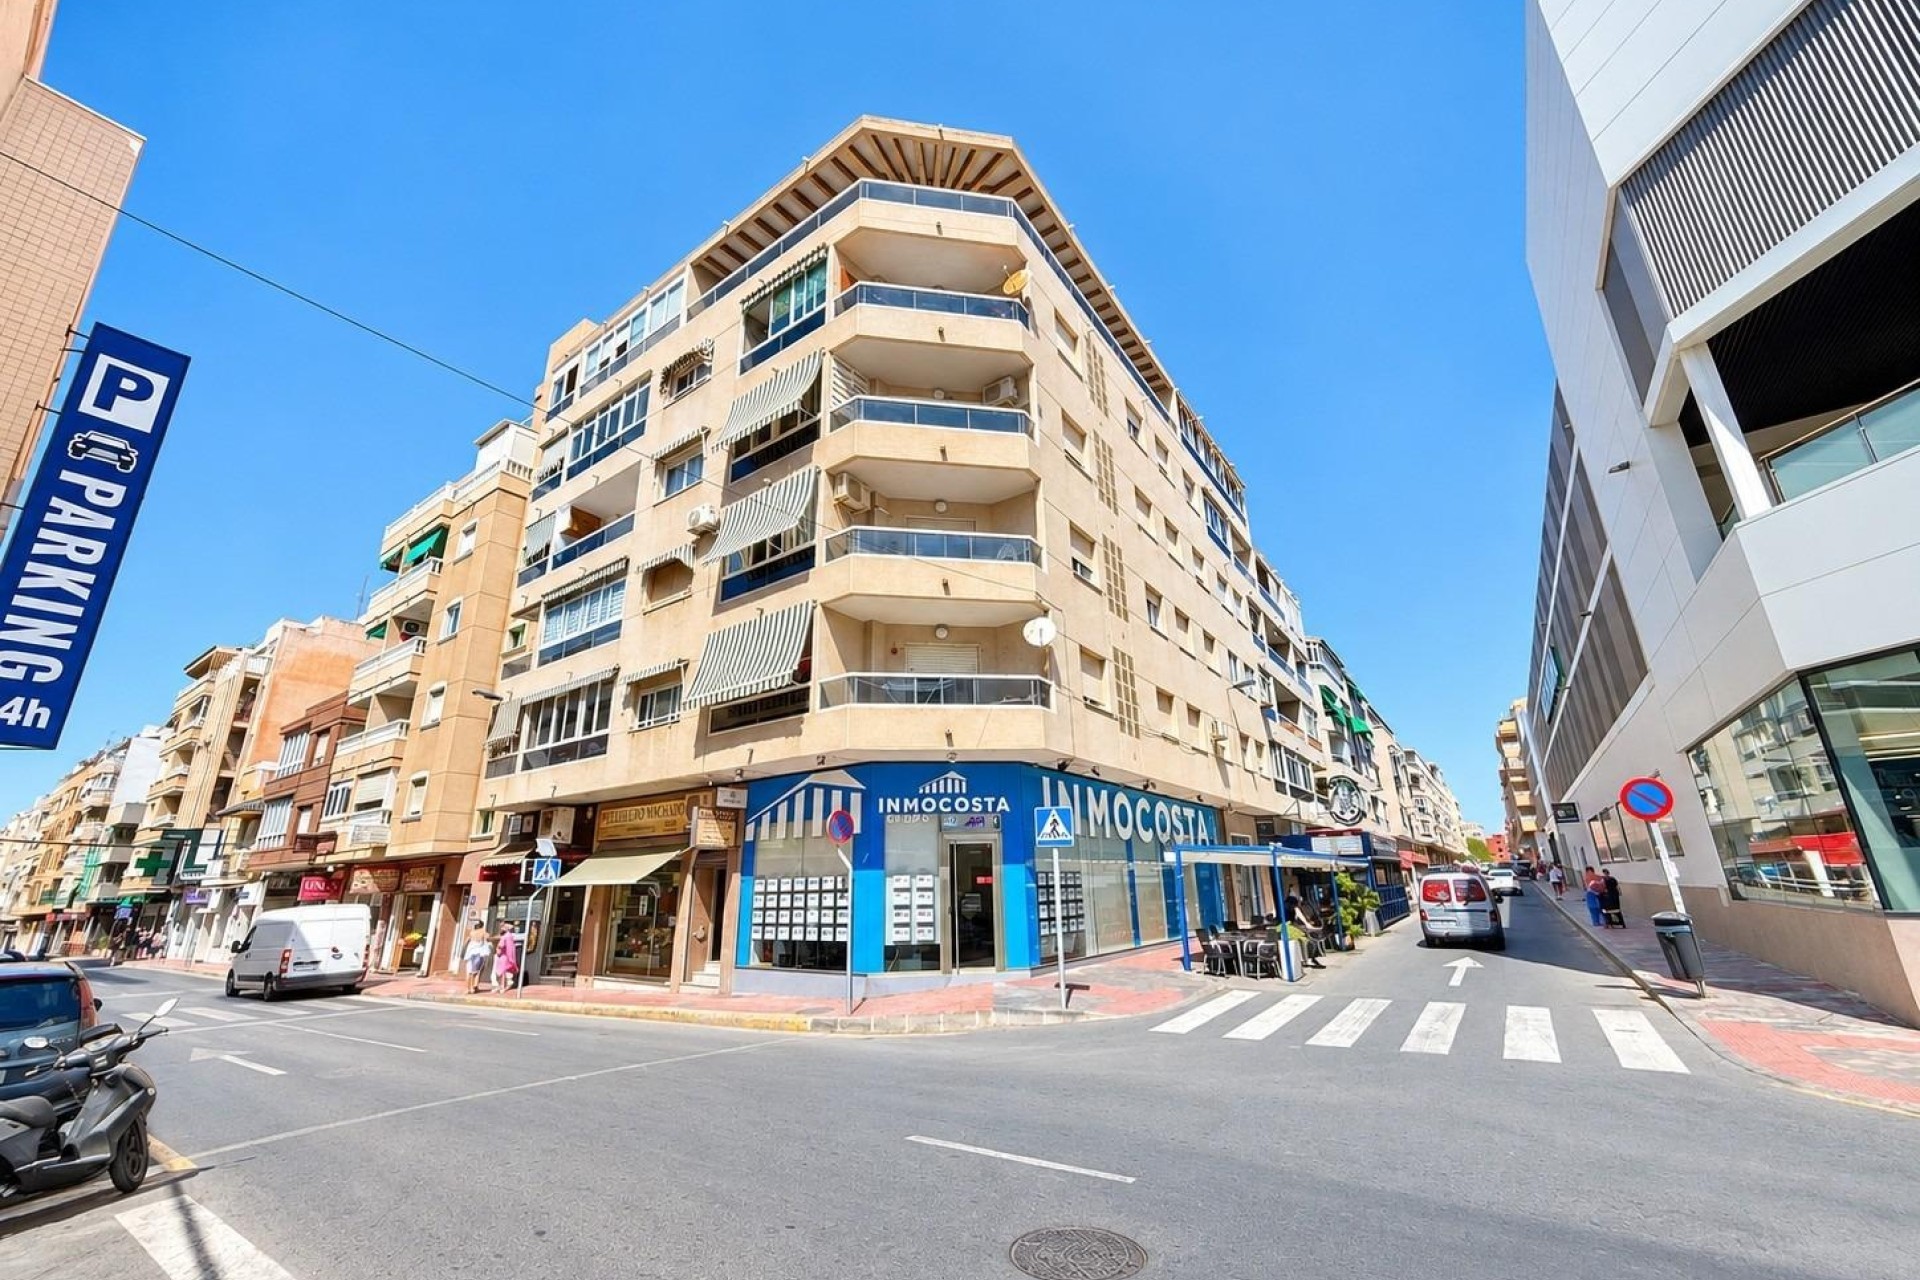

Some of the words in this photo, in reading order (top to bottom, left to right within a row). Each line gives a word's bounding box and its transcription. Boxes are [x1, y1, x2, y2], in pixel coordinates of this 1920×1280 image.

[93, 363, 154, 412] P
[0, 469, 127, 683] PARKING
[879, 797, 1010, 814] INMOCOSTA
[1042, 776, 1210, 846] INMOCOSTA
